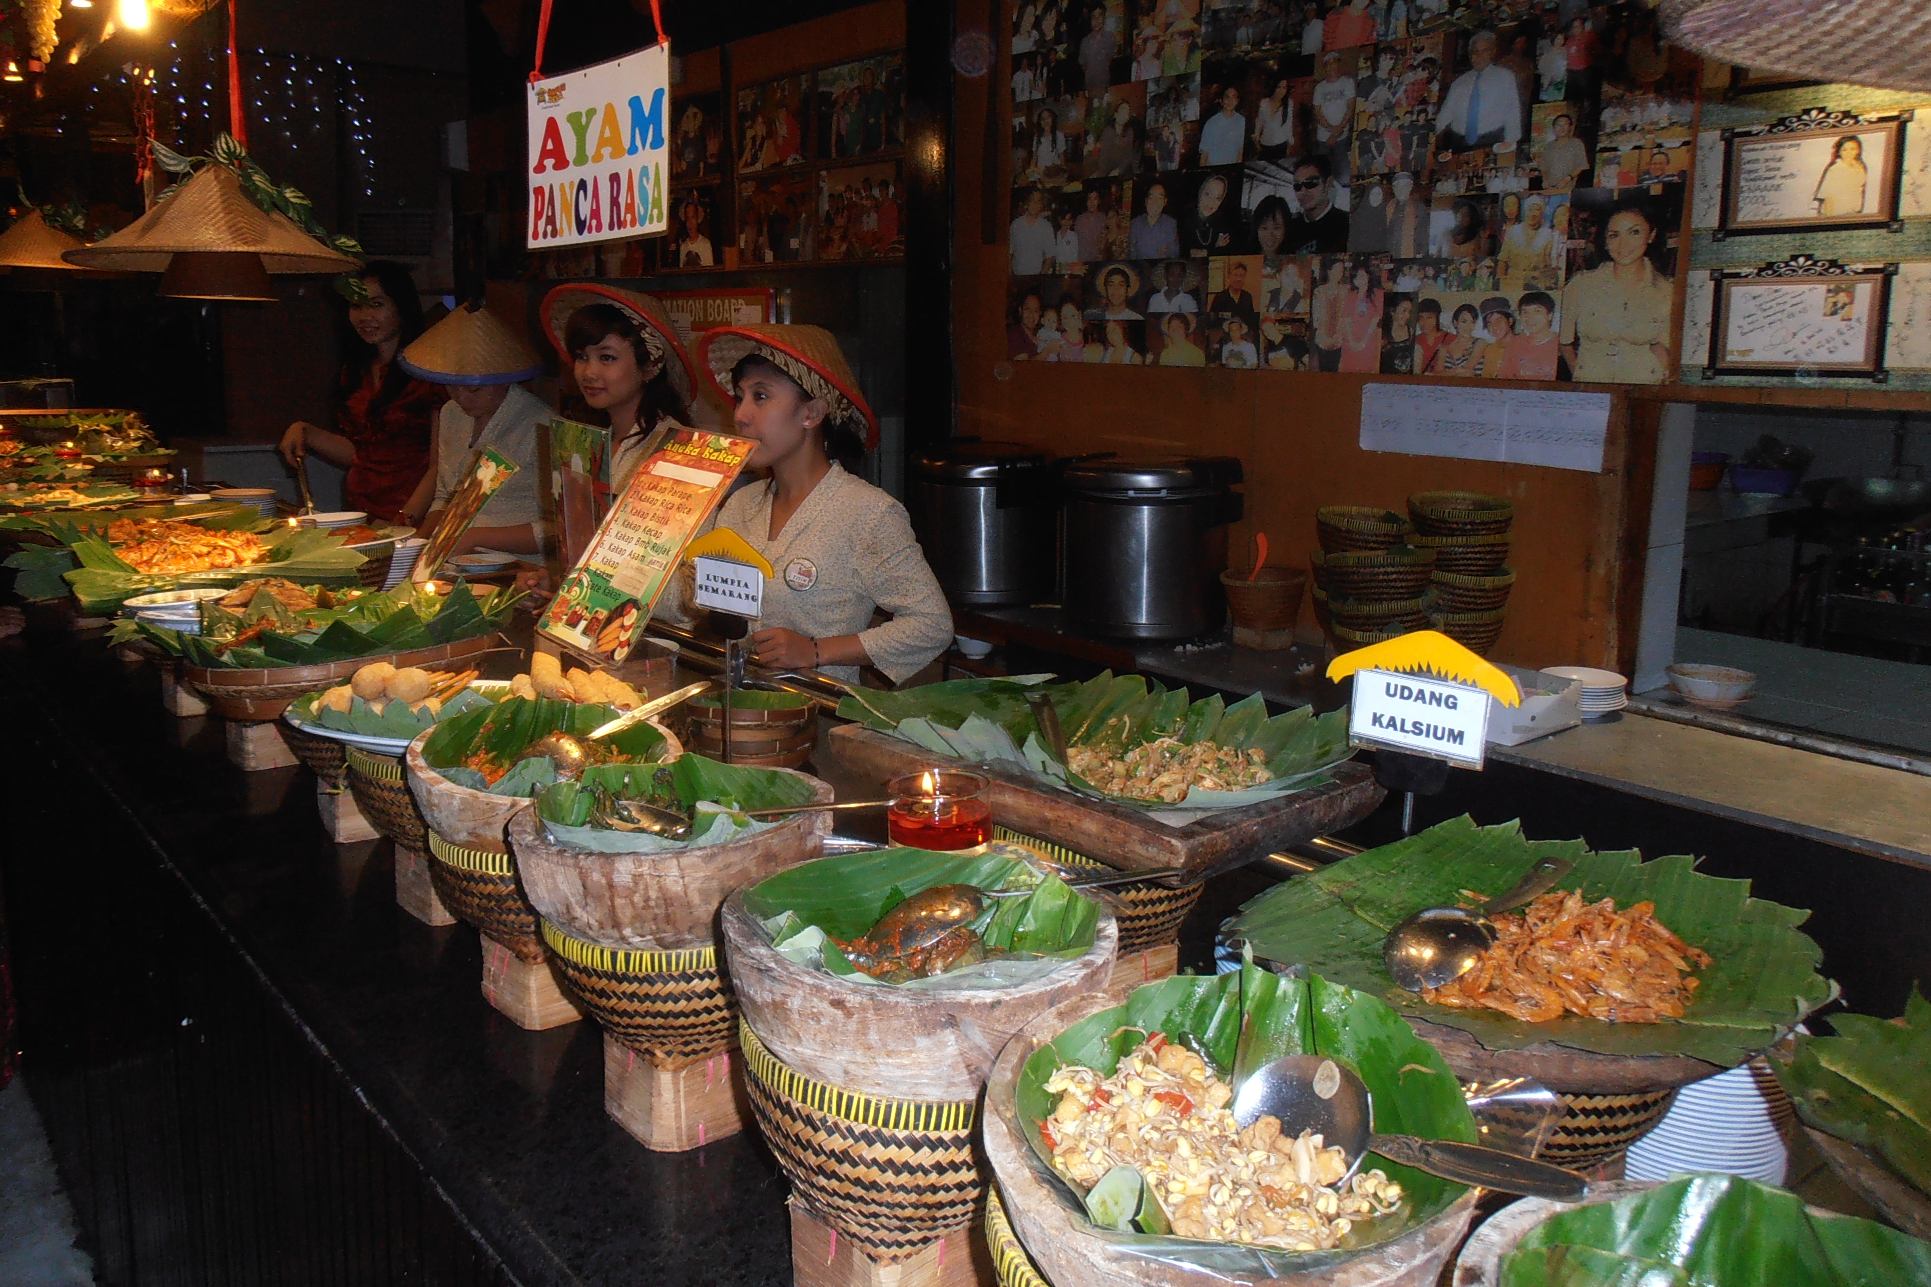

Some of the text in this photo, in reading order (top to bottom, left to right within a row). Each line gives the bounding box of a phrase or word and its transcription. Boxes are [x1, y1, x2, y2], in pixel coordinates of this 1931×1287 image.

[533, 87, 665, 174] AYAM
[532, 162, 663, 241] PANCA RASA
[707, 298, 746, 322] BOA
[663, 439, 743, 467] Aneka Kakap
[639, 493, 659, 506] Kakap
[659, 499, 675, 511] Rica
[675, 503, 692, 515] Rica
[630, 507, 649, 521] Kakap
[650, 512, 670, 527] Bistik
[622, 519, 641, 533] Kakap
[642, 525, 663, 540] Kecap
[608, 543, 627, 557] Kakap
[627, 549, 646, 562] Asam
[615, 531, 634, 545] Kakap
[650, 541, 673, 557] Rujak
[600, 555, 620, 569] Kakap
[602, 583, 622, 601] Kakap
[705, 573, 749, 589] LUMPIA
[698, 583, 758, 603] SEMARANG
[1385, 681, 1459, 711] UDANG
[1371, 711, 1465, 746] KALSIUM
